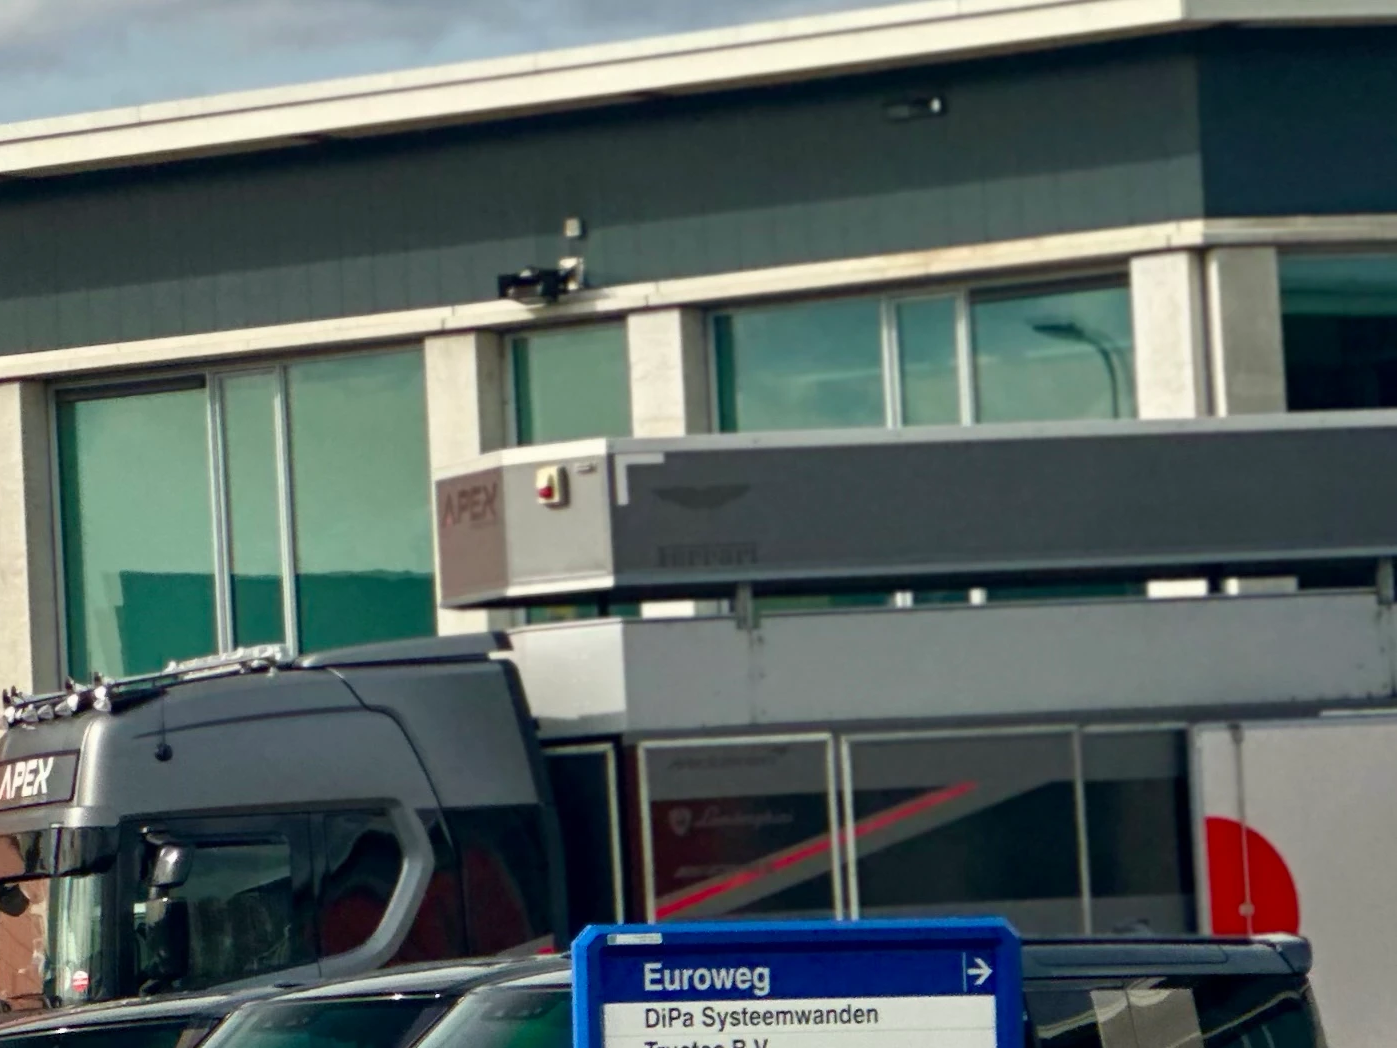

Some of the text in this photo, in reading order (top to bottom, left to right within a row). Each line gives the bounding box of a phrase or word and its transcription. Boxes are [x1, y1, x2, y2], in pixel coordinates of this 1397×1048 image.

[644, 962, 771, 996] Euroweg
[644, 1004, 880, 1032] DiPa Systeemwanden
